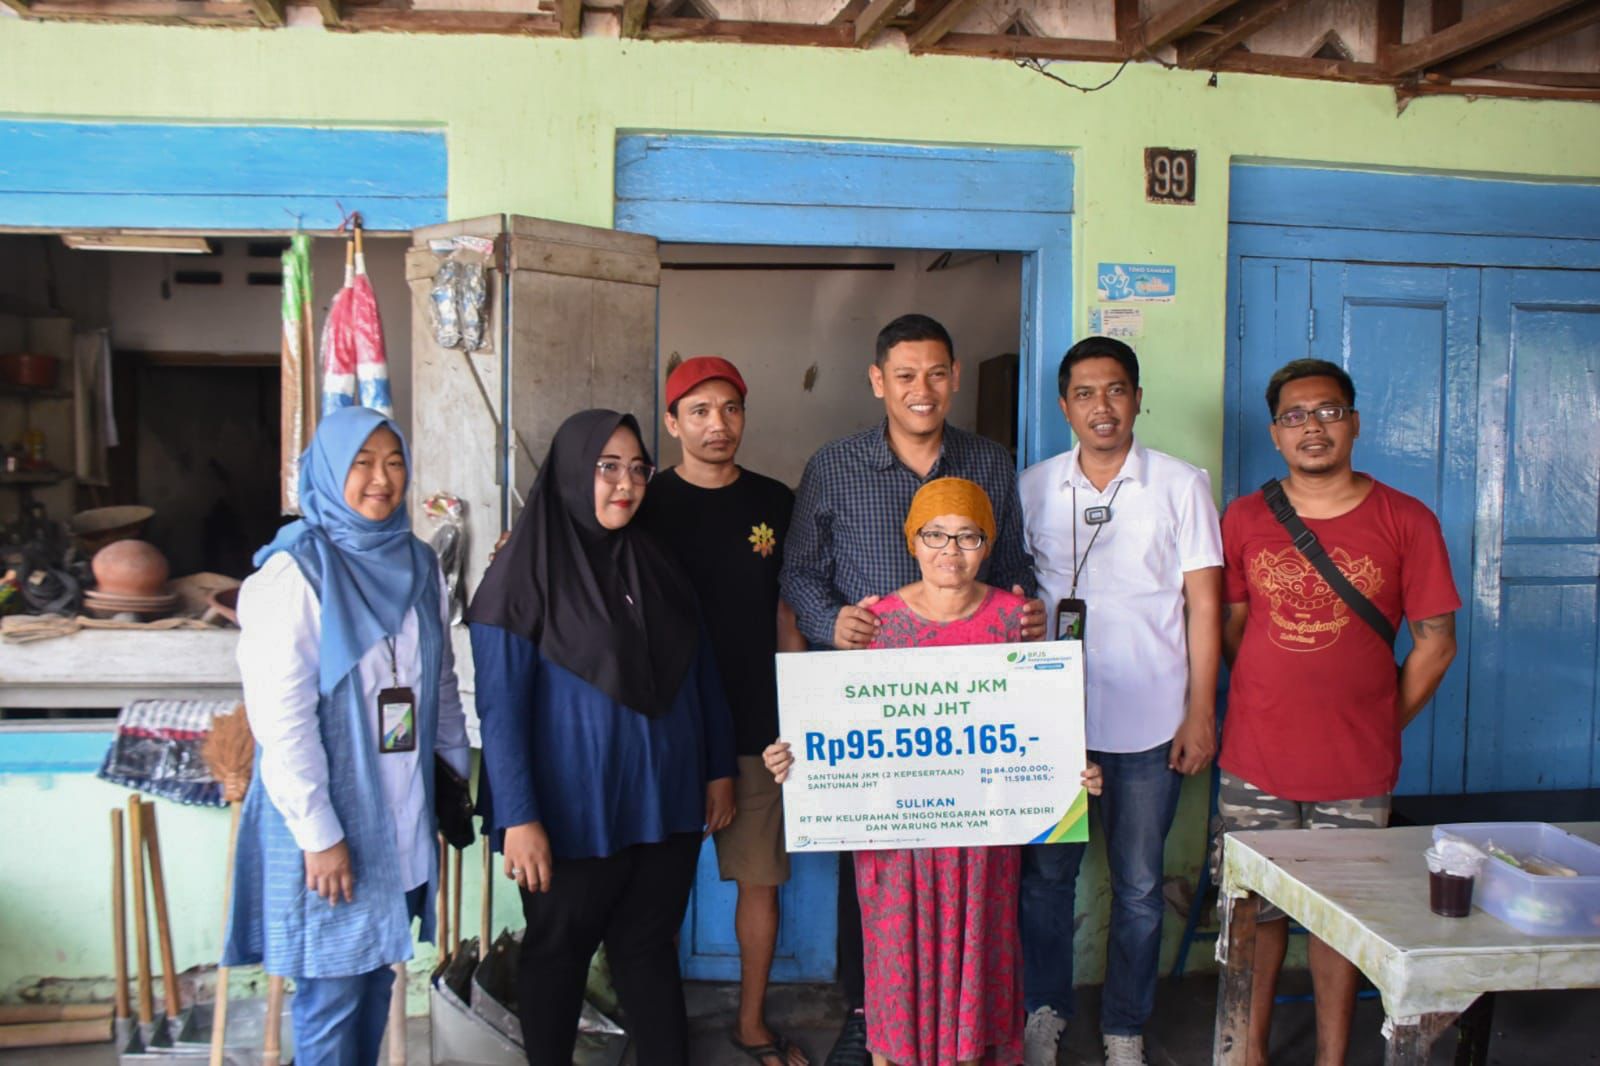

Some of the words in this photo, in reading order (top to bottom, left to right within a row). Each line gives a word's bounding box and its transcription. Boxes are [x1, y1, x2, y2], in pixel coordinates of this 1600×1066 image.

[1154, 156, 1188, 197] 99
[845, 681, 959, 698] SANTUNAN
[967, 678, 1008, 693] JKM
[883, 703, 926, 717] DAN
[934, 701, 971, 715] JHT
[805, 723, 1039, 766] Rp95.598.165,-
[807, 773, 859, 781] SANTUNAN
[882, 771, 891, 779] (2
[894, 769, 965, 777] KEPESERTAAN)
[980, 767, 992, 775] Rp
[807, 781, 859, 789] SANTUNAN
[980, 776, 993, 784] Rp
[896, 798, 956, 809] SULIKAN
[799, 815, 813, 823] RT
[836, 813, 899, 822] KELURAHAN
[902, 810, 986, 820] SINGONEGARAN
[989, 808, 1016, 816] KOTA
[1020, 806, 1054, 815] KEDIRI
[866, 823, 888, 832] DAN
[891, 821, 938, 830] WARUNG
[941, 820, 964, 829] MAK
[967, 819, 989, 828] YAM
